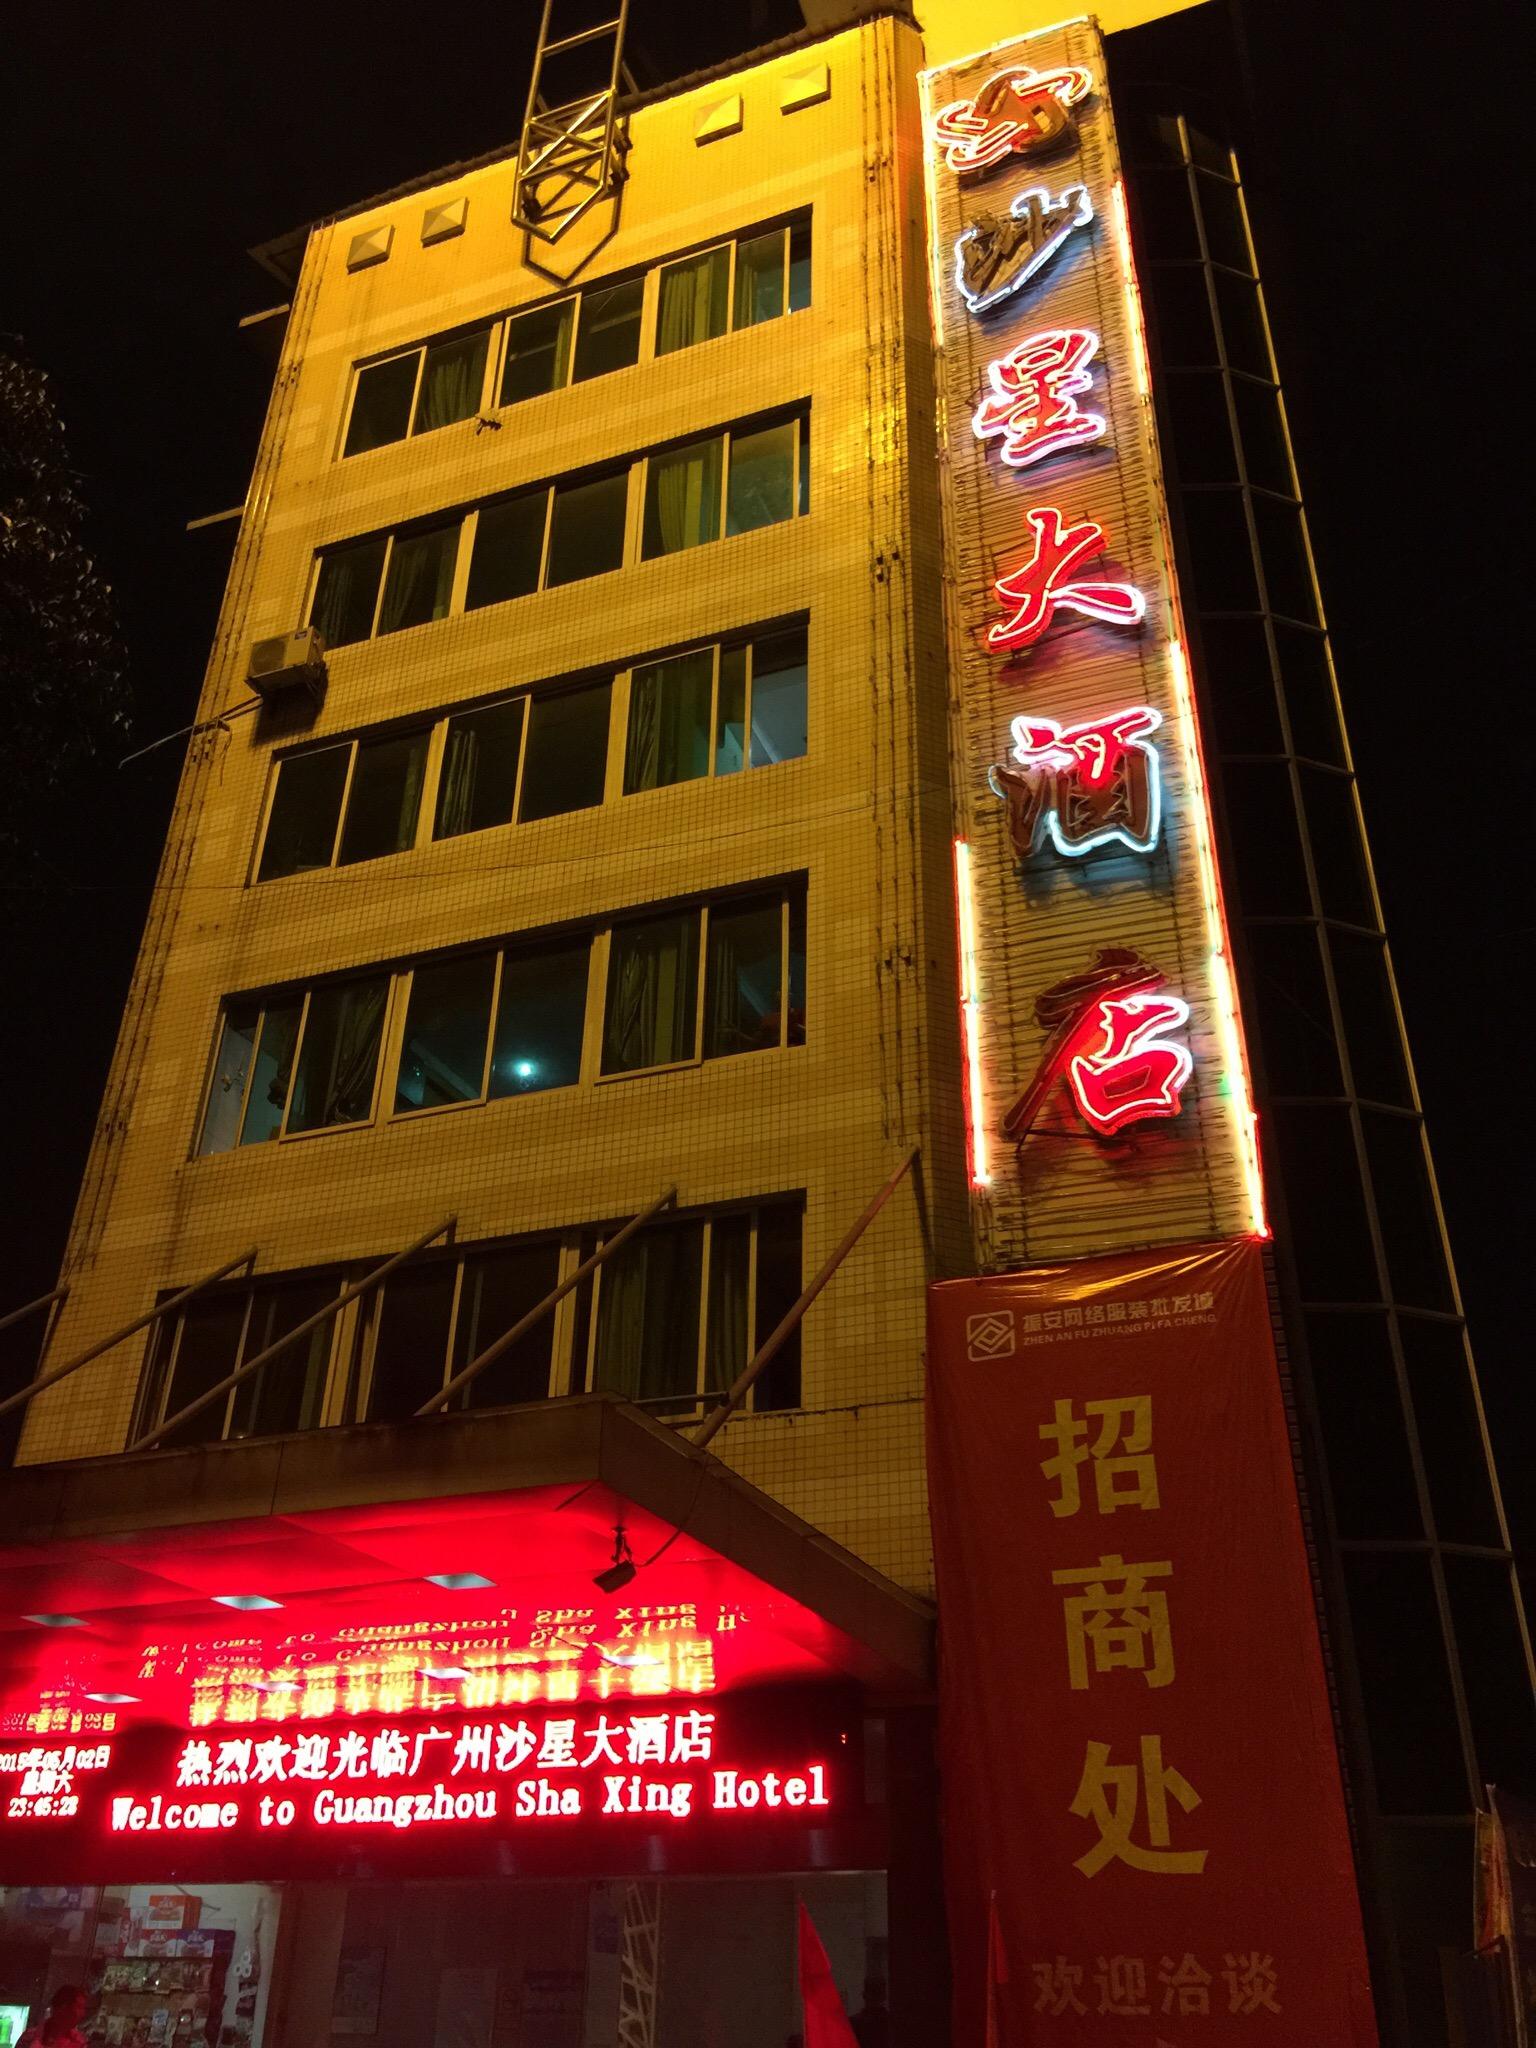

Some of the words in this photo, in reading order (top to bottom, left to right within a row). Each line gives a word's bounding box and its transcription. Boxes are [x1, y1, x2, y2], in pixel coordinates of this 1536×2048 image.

[1023, 1333, 1054, 1346] ZHEN
[1056, 1331, 1074, 1343] AN
[1075, 1329, 1090, 1341] FU
[1091, 1324, 1142, 1339] ZHUANG
[1144, 1321, 1156, 1332] PI
[1157, 1319, 1172, 1330] FA
[1174, 1314, 1217, 1327] CHENG
[1038, 1394, 1209, 1880] 招商处
[176, 1709, 716, 1787] 热烈欢迎光临广州沙星大酒店
[111, 1796, 239, 1832] Welcome
[259, 1796, 296, 1826] to
[313, 1783, 497, 1828] Guangzhou
[515, 1778, 582, 1817] Sha
[602, 1775, 693, 1818] Xing
[712, 1765, 829, 1809] Hotel
[1031, 1950, 1282, 2017] 欢迎洽谈
